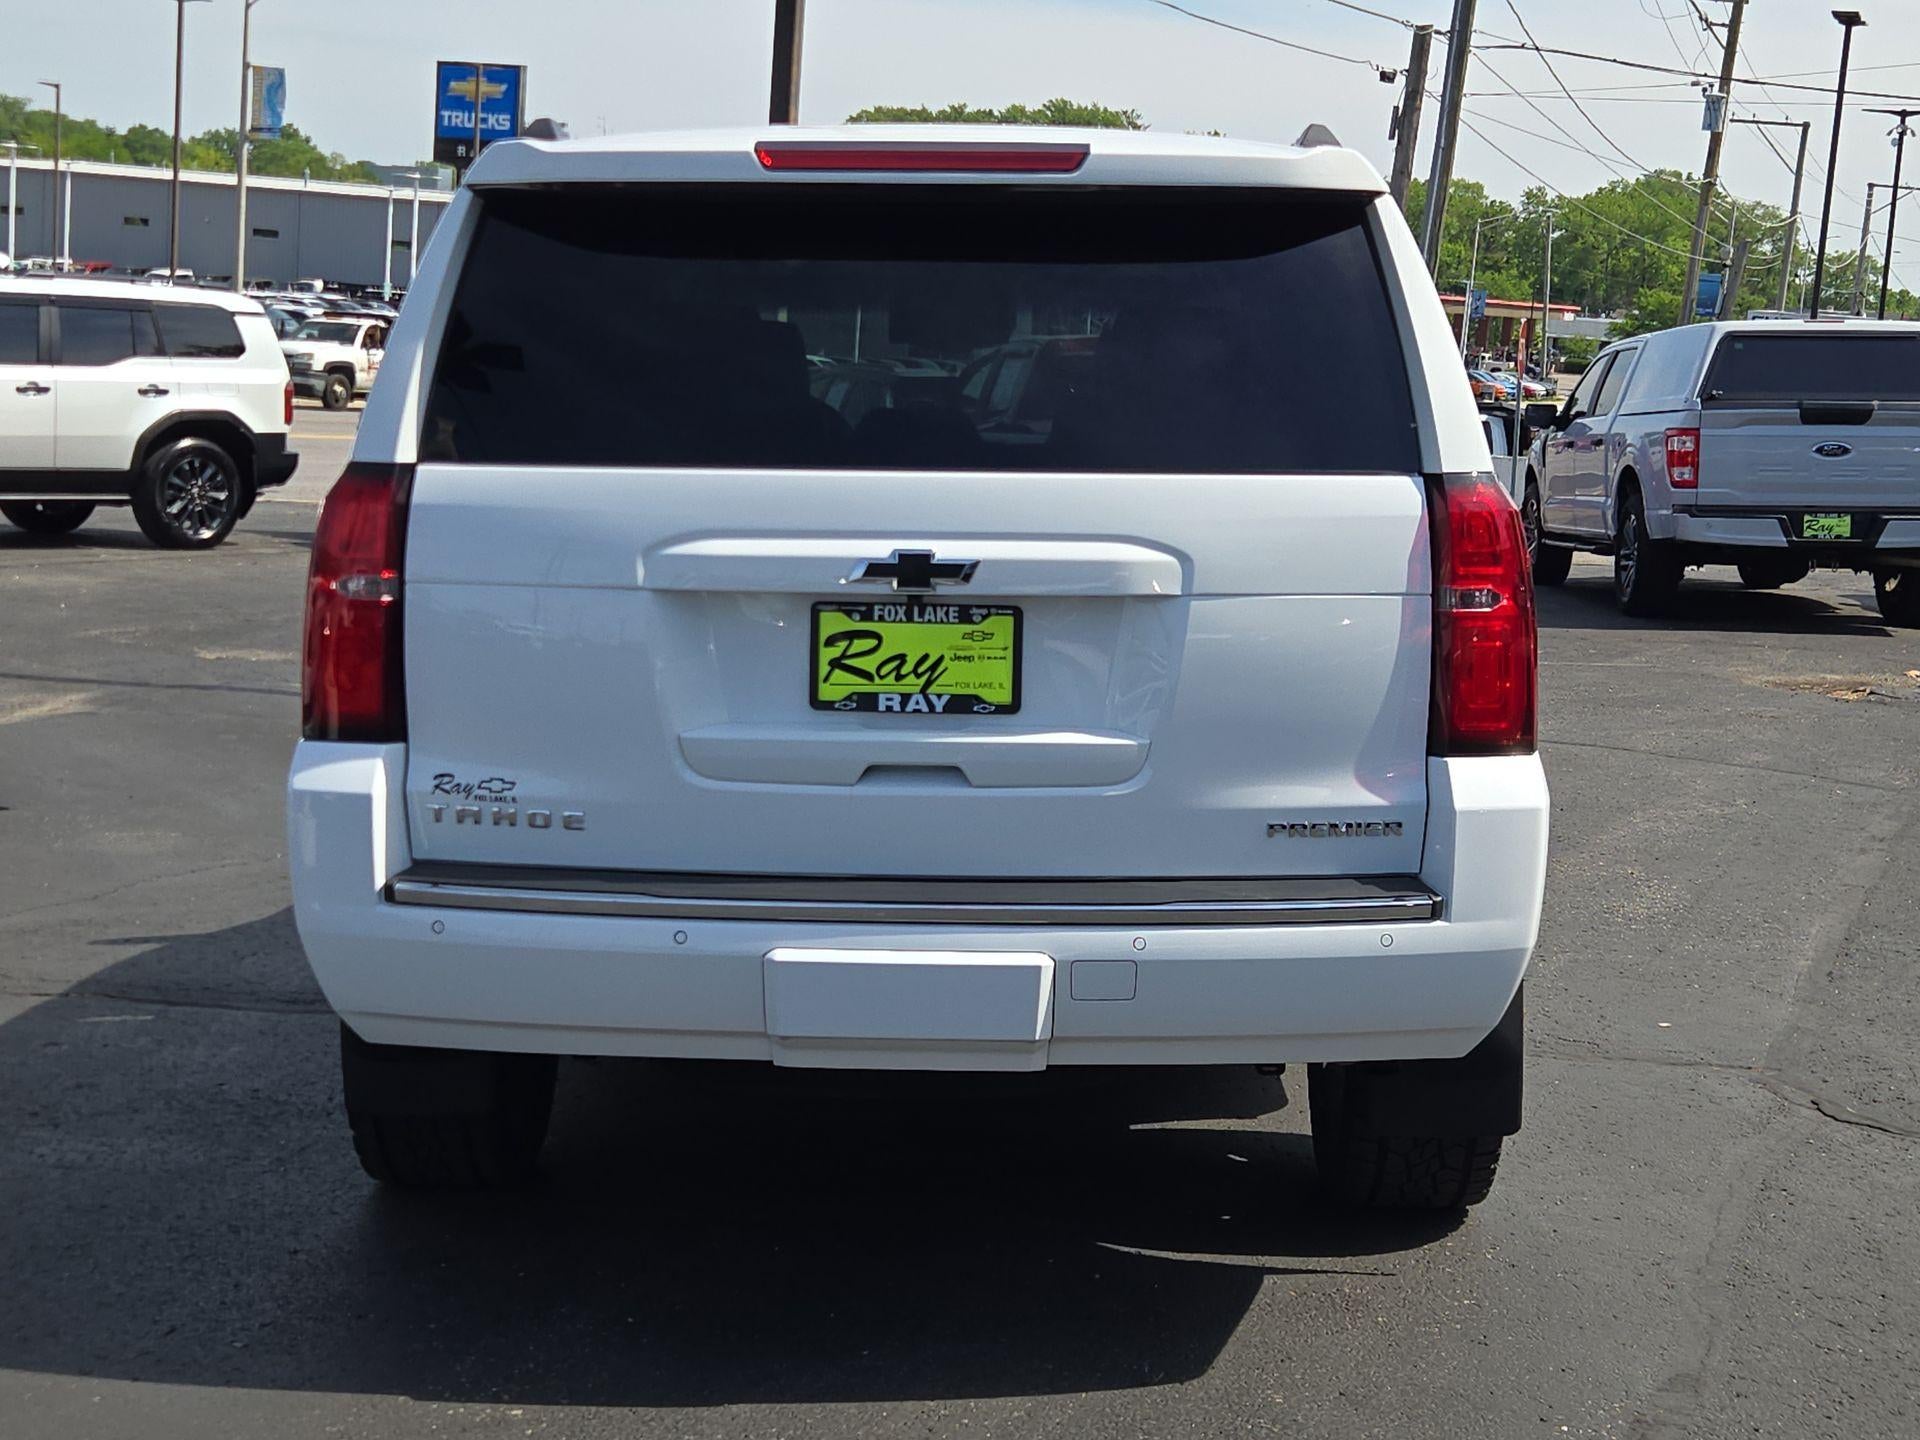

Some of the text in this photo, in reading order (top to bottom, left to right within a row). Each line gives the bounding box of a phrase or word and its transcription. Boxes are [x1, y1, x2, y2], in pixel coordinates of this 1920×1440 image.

[440, 110, 511, 130] TRUCKS
[873, 605, 960, 623] FOX LAKE
[823, 629, 948, 694] Ray
[949, 653, 975, 662] Jeep
[955, 681, 971, 689] FOX
[878, 693, 951, 713] RAY
[432, 773, 476, 800] Ray
[425, 803, 586, 831] TAHOE
[1266, 821, 1404, 838] PREMIER
